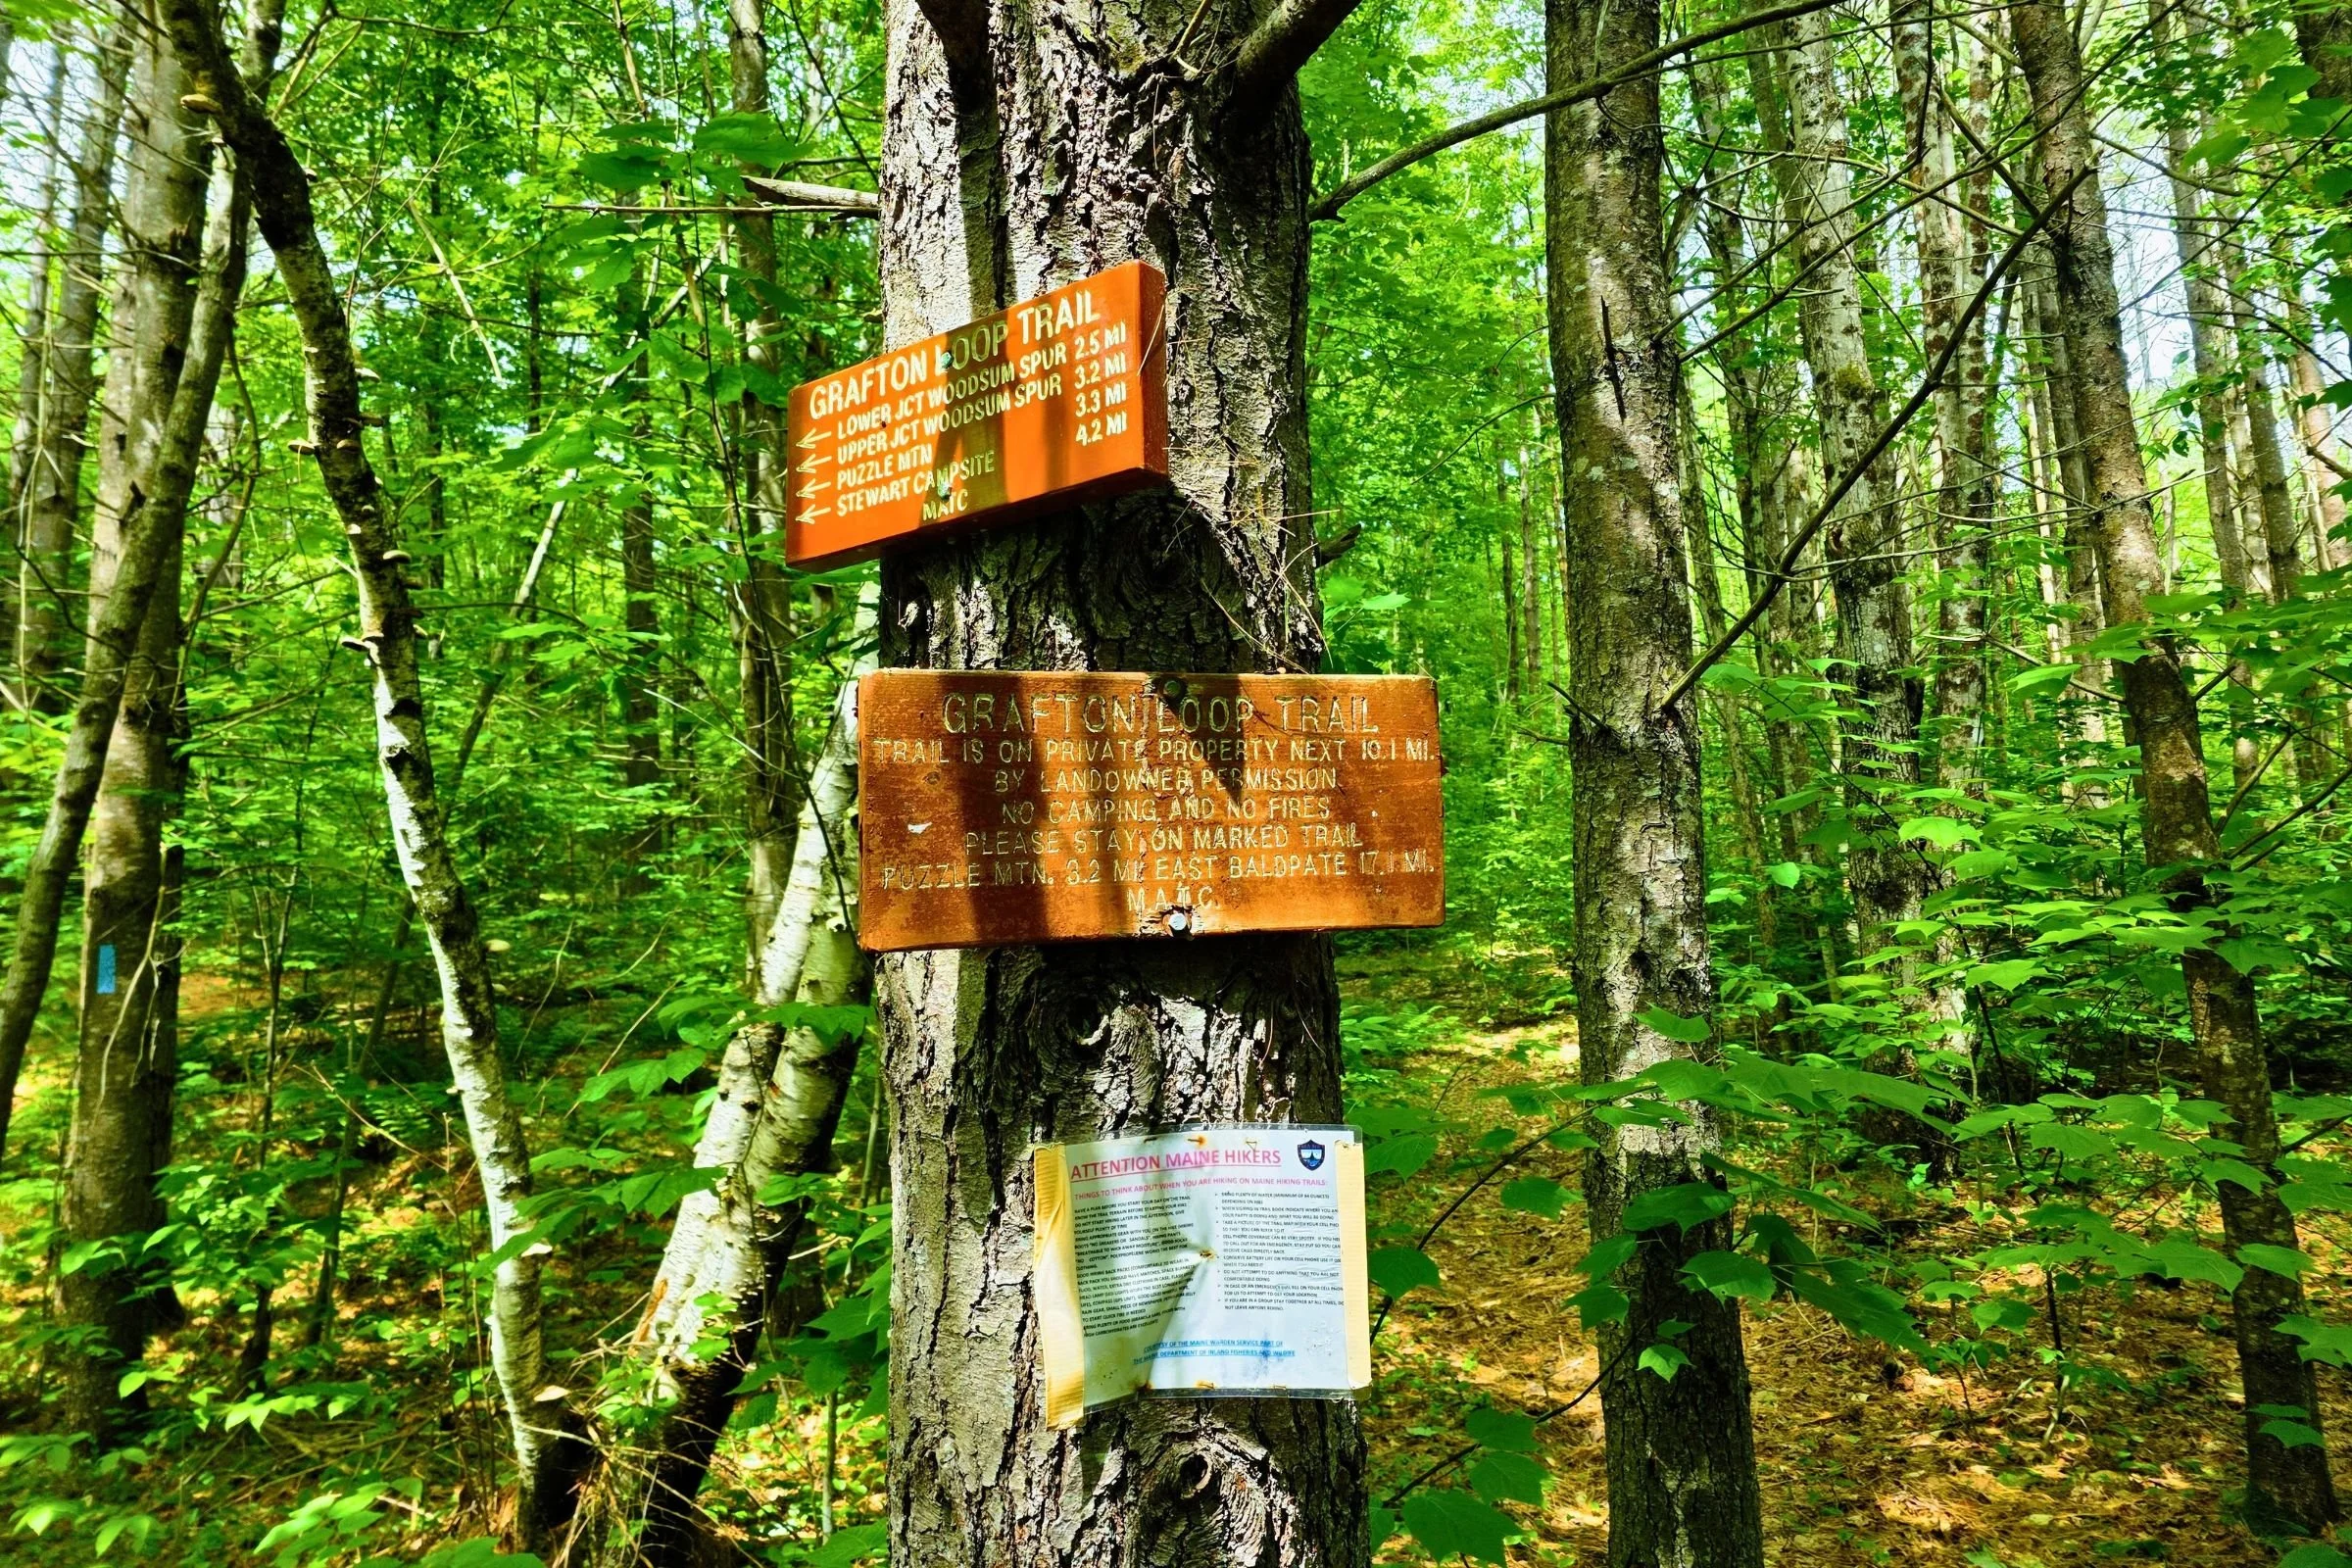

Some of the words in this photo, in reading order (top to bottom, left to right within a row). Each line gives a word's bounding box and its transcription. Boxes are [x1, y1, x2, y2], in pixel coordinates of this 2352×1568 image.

[809, 349, 927, 419] GRAFTON
[934, 319, 1008, 376] LOOP
[1017, 290, 1101, 345] TRAIL
[837, 406, 891, 439] LOWER
[895, 390, 923, 422] JCT
[927, 366, 1014, 407] WOODSUM
[1019, 342, 1067, 378] SPUR
[1074, 334, 1101, 361] 2.5
[1103, 321, 1126, 350] MI
[837, 432, 888, 466] UPPER
[890, 417, 919, 446] JCT
[923, 396, 1010, 436] WOODSUM
[1014, 373, 1062, 409] SPUR
[1074, 365, 1101, 390] 3.2
[1104, 352, 1126, 377] MI
[837, 460, 894, 490] PUZZLE
[898, 444, 932, 473] MTN
[1075, 393, 1102, 418] 3.3
[1104, 381, 1127, 408] MI
[837, 479, 908, 517] STEWART
[913, 451, 995, 494] CAMPSITE
[1076, 420, 1102, 447] 4.2
[1106, 412, 1127, 437] MI
[923, 489, 968, 521] MATC
[942, 692, 1136, 734] GRAFTON
[1156, 698, 1253, 733] LOOP
[1276, 696, 1379, 733] TRAIL
[872, 738, 949, 762] TRAIL
[962, 741, 984, 762] IS
[1000, 739, 1033, 762] ON
[1046, 739, 1149, 762] PRIVATE
[1159, 739, 1279, 760] PROPERTY
[1291, 740, 1347, 760] NEXT
[996, 768, 1025, 792] BY
[1041, 767, 1194, 792] LANDOWNER
[1201, 767, 1337, 790] PERMISSION
[1002, 802, 1034, 825] NO
[1170, 796, 1215, 819] AND
[1227, 800, 1256, 819] NO
[1269, 798, 1331, 819] FIRES
[966, 831, 1060, 855] PLEASE
[1074, 829, 1137, 854] STAY
[1151, 827, 1183, 851] ON
[1194, 825, 1288, 849] MARKED
[1301, 823, 1362, 847] TRAIL
[882, 862, 980, 890] PUZZLE
[1066, 859, 1101, 886] 3.2
[1155, 854, 1218, 880] EAST
[1229, 853, 1348, 878] BALDPATE
[1071, 1155, 1160, 1179] ATTENTION
[1166, 1150, 1219, 1167] MAINE
[1225, 1150, 1281, 1164] HIKERS
